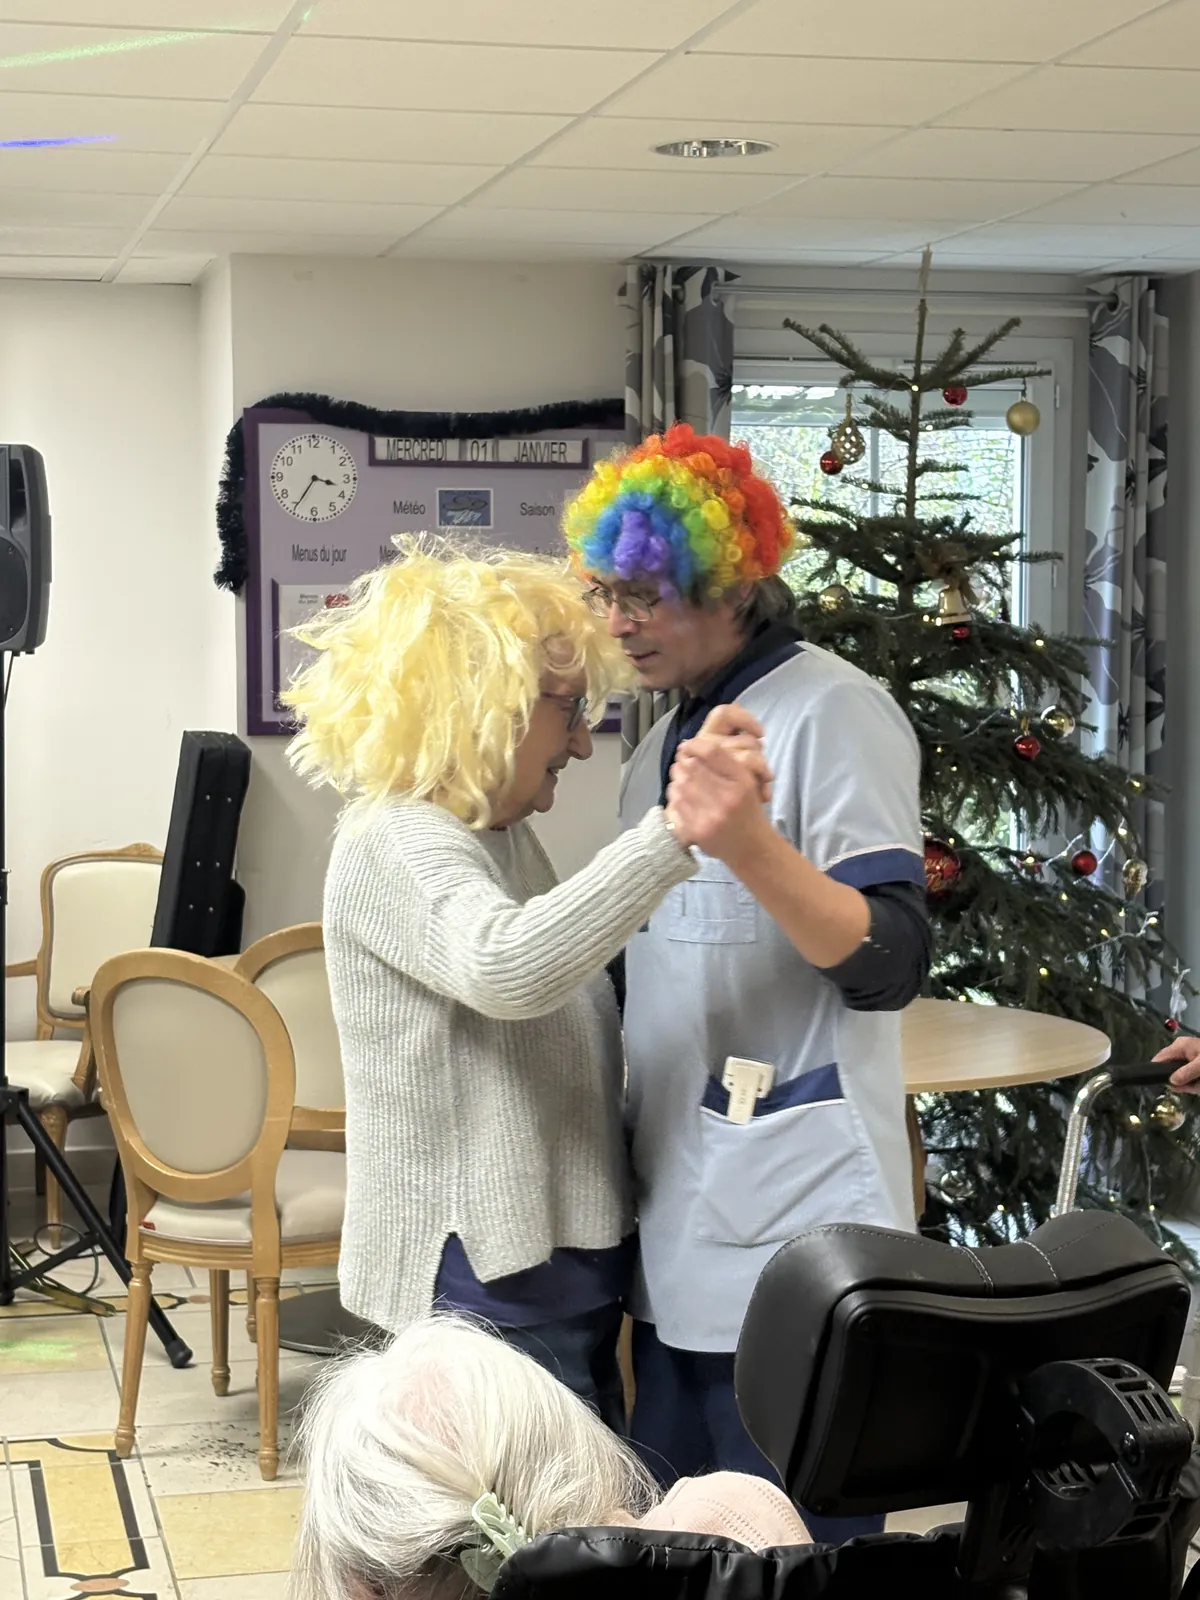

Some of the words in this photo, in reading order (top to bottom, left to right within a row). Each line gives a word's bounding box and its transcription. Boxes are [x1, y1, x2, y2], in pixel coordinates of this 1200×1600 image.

[307, 438, 320, 449] 12
[291, 445, 302, 454] 11
[330, 445, 336, 454] 1
[387, 439, 447, 461] MERCREDI
[470, 440, 488, 462] 01
[514, 441, 567, 463] JANVIER
[280, 456, 294, 466] 10
[339, 457, 347, 467] 2
[276, 472, 284, 482] 9
[343, 474, 351, 484] 3
[281, 489, 289, 499] 8
[338, 490, 346, 500] 4
[310, 507, 318, 517] 6
[329, 502, 337, 512] 5
[393, 500, 426, 515] Météo
[520, 502, 555, 516] Saison
[291, 544, 319, 562] Menus
[320, 544, 330, 562] du
[331, 544, 348, 567] jour
